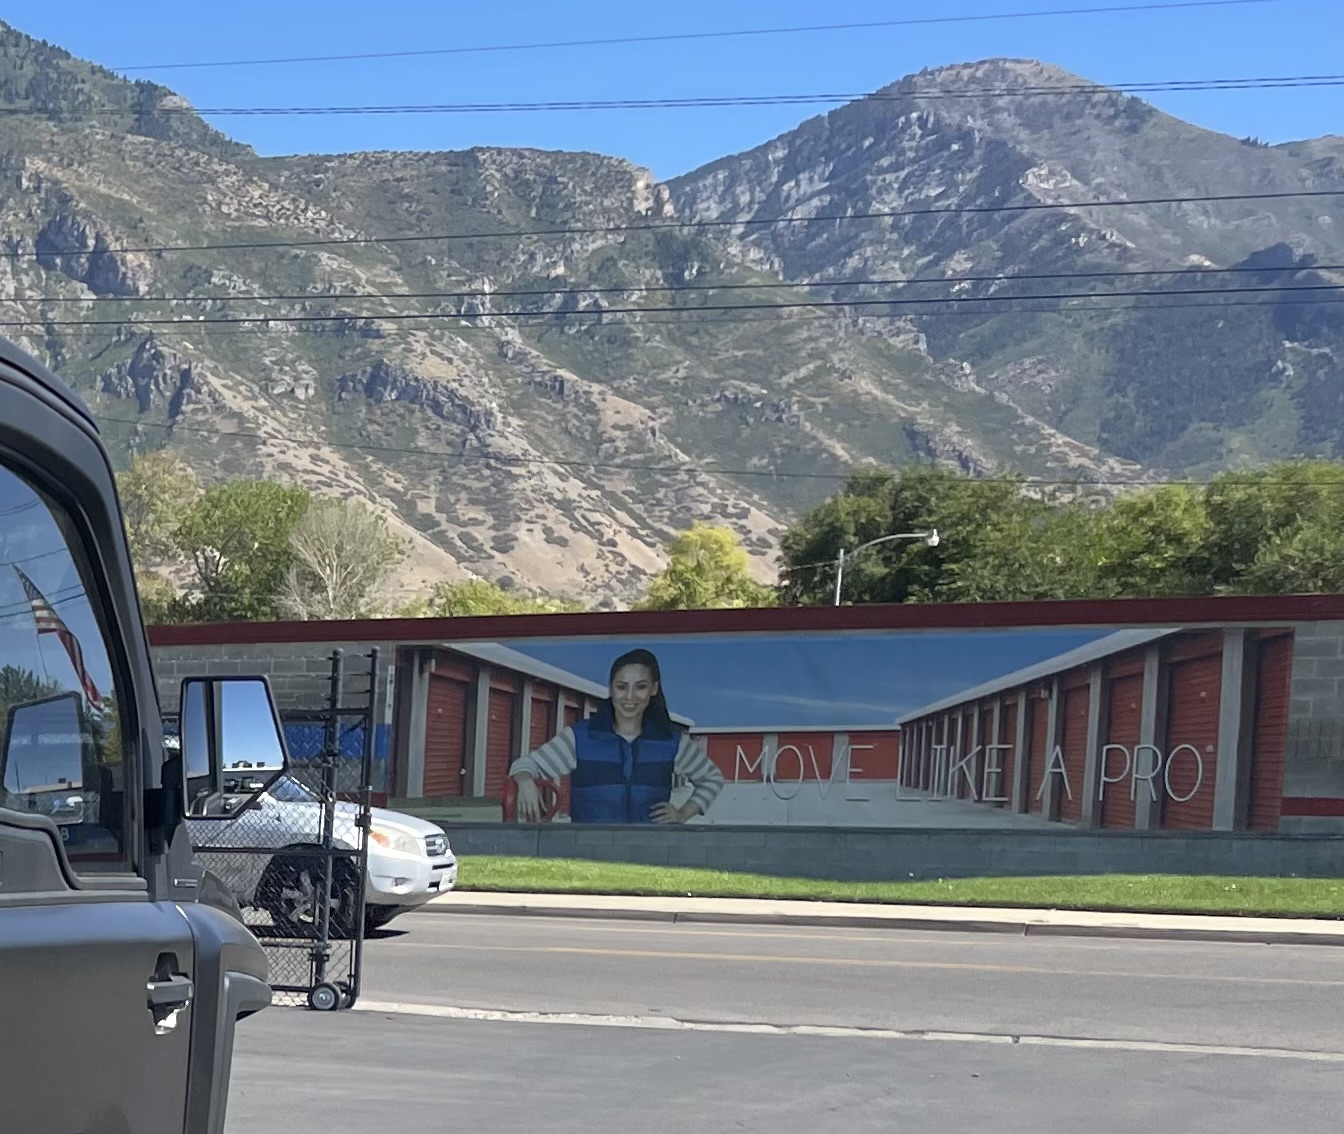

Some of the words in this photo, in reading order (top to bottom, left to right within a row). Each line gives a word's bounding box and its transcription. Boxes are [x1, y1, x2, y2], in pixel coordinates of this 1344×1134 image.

[734, 743, 876, 802] MOVE
[896, 743, 1013, 803] LIKE
[1035, 743, 1072, 801] A
[1098, 742, 1203, 802] PRO
